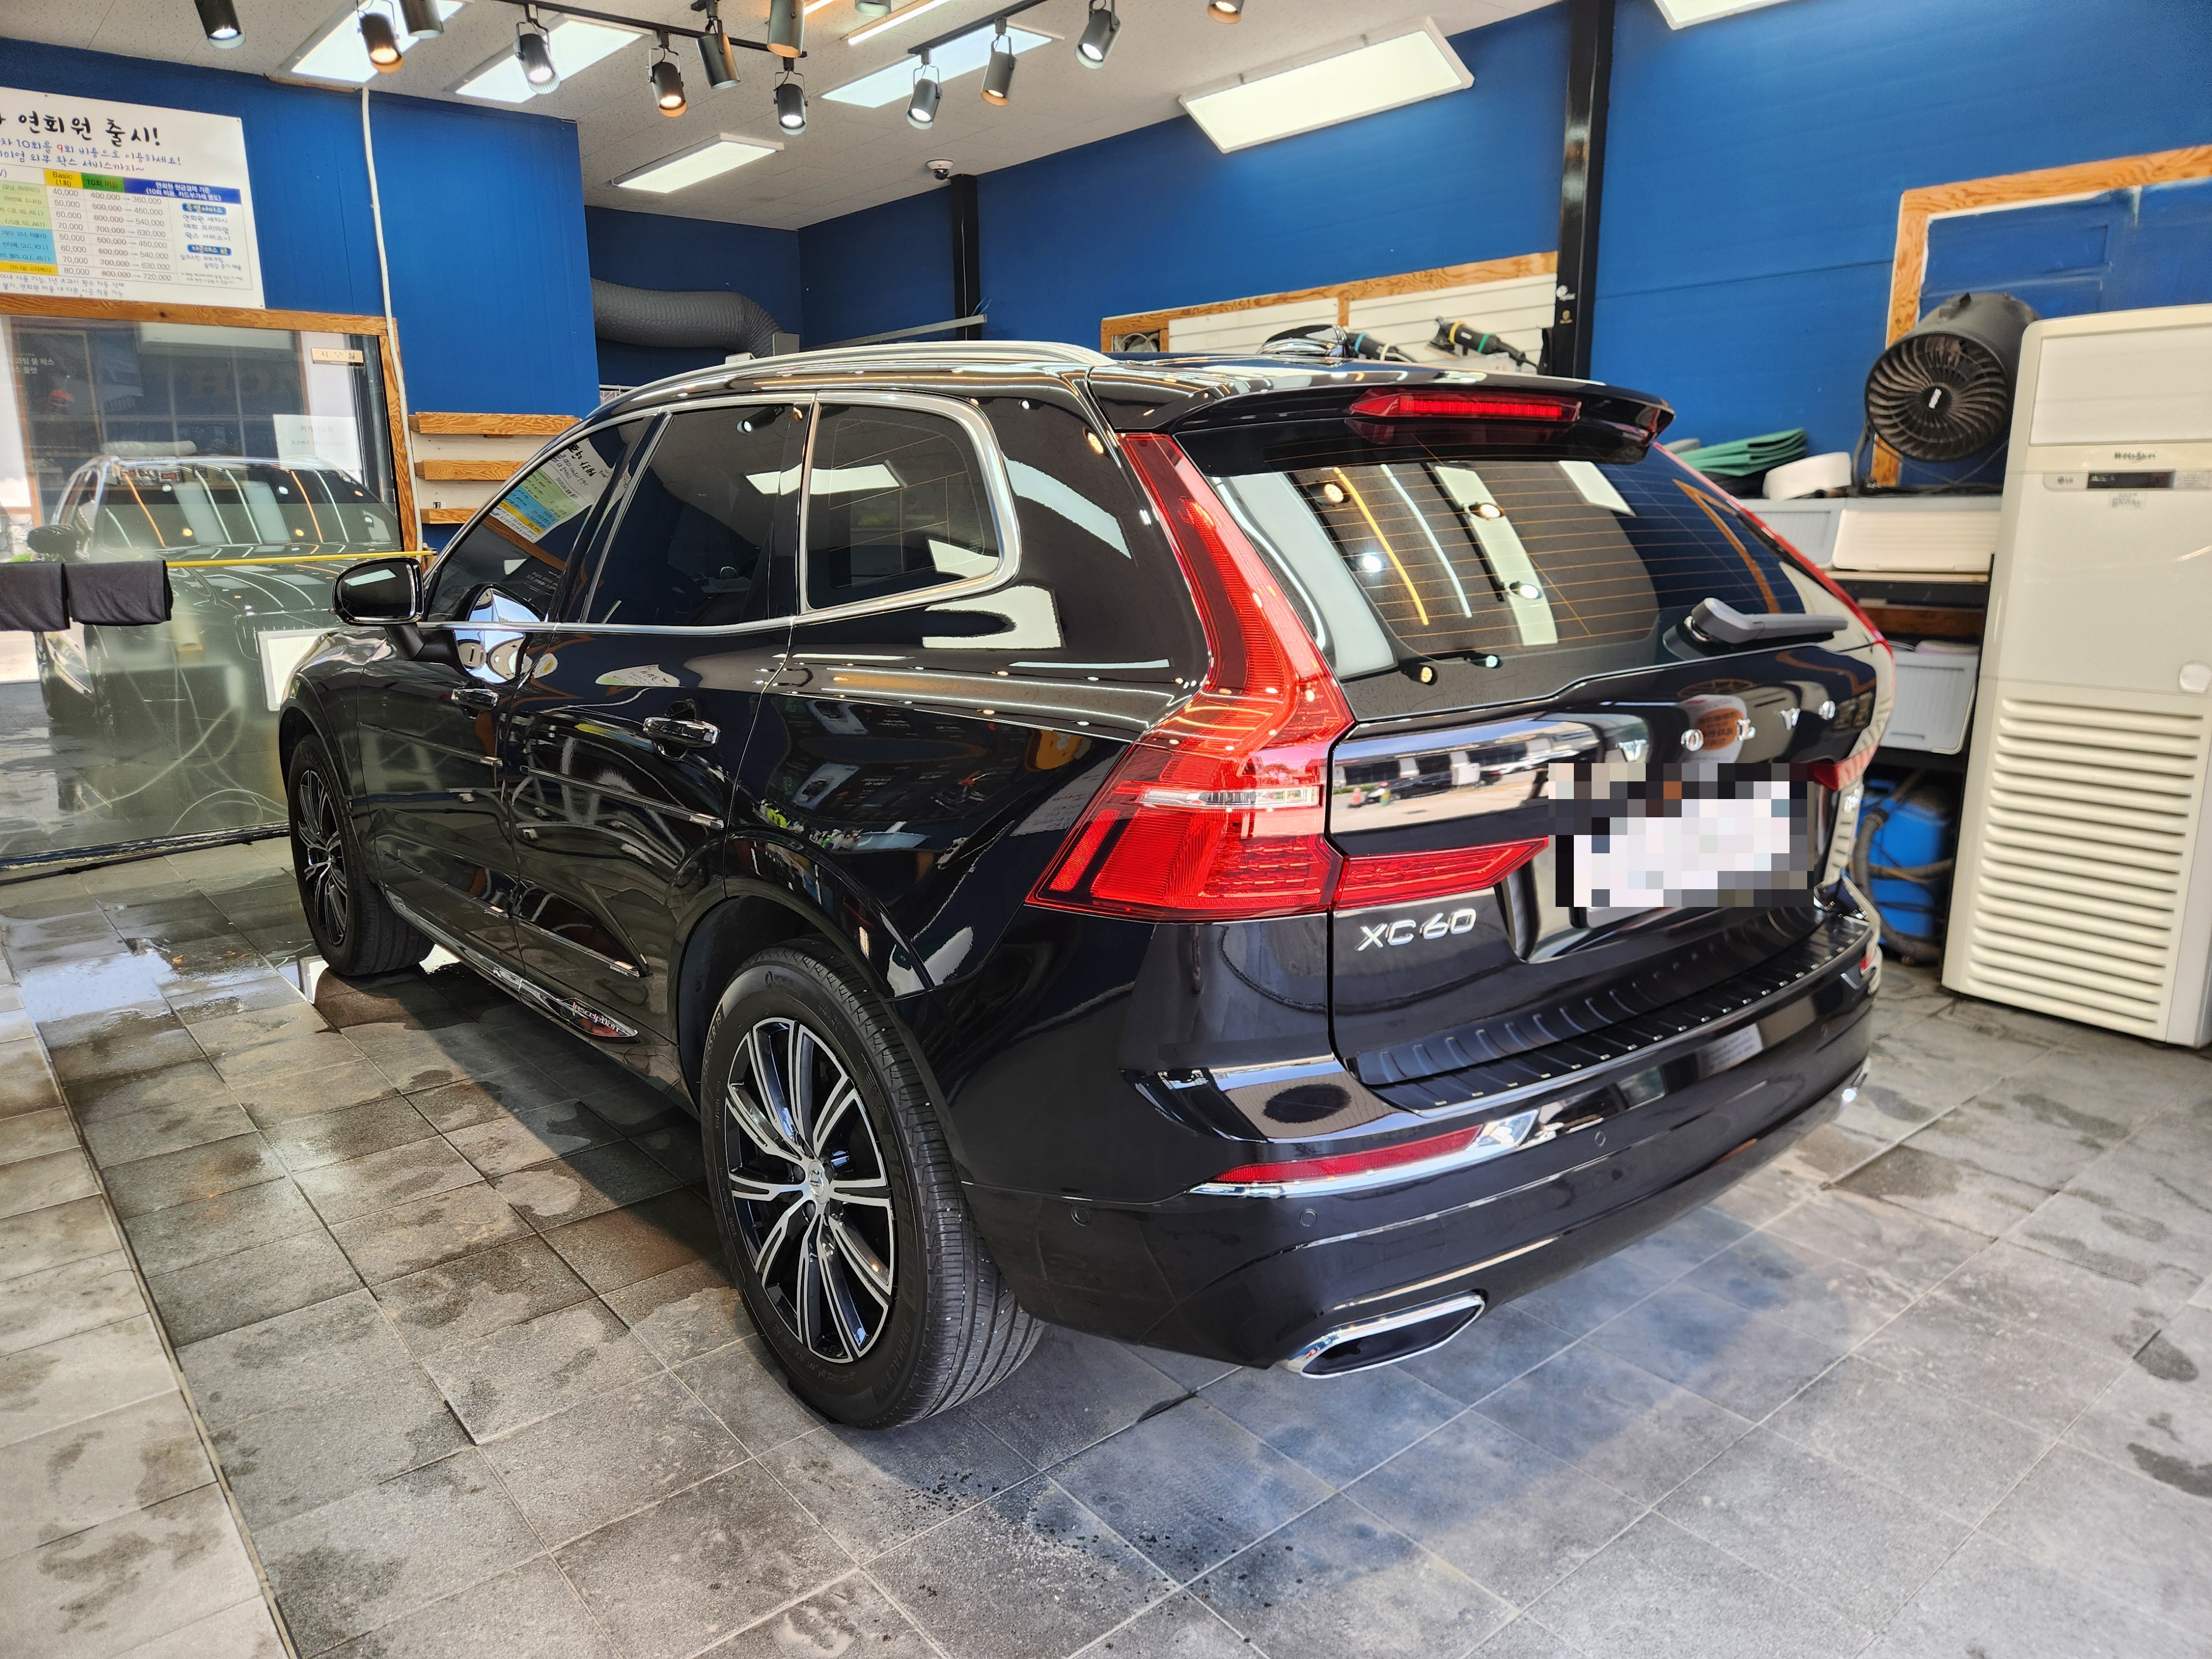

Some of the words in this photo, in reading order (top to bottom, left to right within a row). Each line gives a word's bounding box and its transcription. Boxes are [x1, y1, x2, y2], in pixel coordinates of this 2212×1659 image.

[18, 110, 92, 140] 연회원
[105, 118, 160, 147] 출시!
[15, 139, 53, 154] 10회를
[56, 144, 74, 153] 9회
[79, 147, 121, 159] 비용으로
[125, 152, 181, 166] 이용하세요!
[30, 154, 51, 164] 외부
[56, 155, 78, 168] 왁스
[53, 171, 73, 180] Basic
[56, 179, 72, 187] (1회)
[53, 188, 79, 197] 40,000
[91, 192, 121, 201] 400,000
[132, 196, 161, 205] 360,000
[54, 200, 80, 208] 50,000
[92, 203, 122, 212] 500,000
[134, 207, 163, 216] 450,000
[56, 211, 82, 220] 60,000
[94, 214, 124, 223] 600,000
[135, 218, 164, 227] 540,000
[58, 222, 84, 231] 70,000
[96, 226, 125, 234] 700,000
[137, 229, 166, 238] 630,000
[59, 233, 85, 242] 50,000
[97, 237, 127, 246] 500,000
[139, 240, 168, 249] 450,000
[61, 245, 87, 253] 60,000
[98, 248, 128, 257] 600,000
[140, 251, 169, 260] 540,000
[62, 256, 88, 265] 70,000
[101, 259, 130, 268] 700,000
[142, 262, 170, 271] 630,000
[64, 267, 90, 275] 80,000
[102, 270, 131, 279] 800,000
[143, 273, 172, 281] 720,000
[1616, 700, 1836, 762] VOLVO
[1355, 908, 1477, 951] XC60
